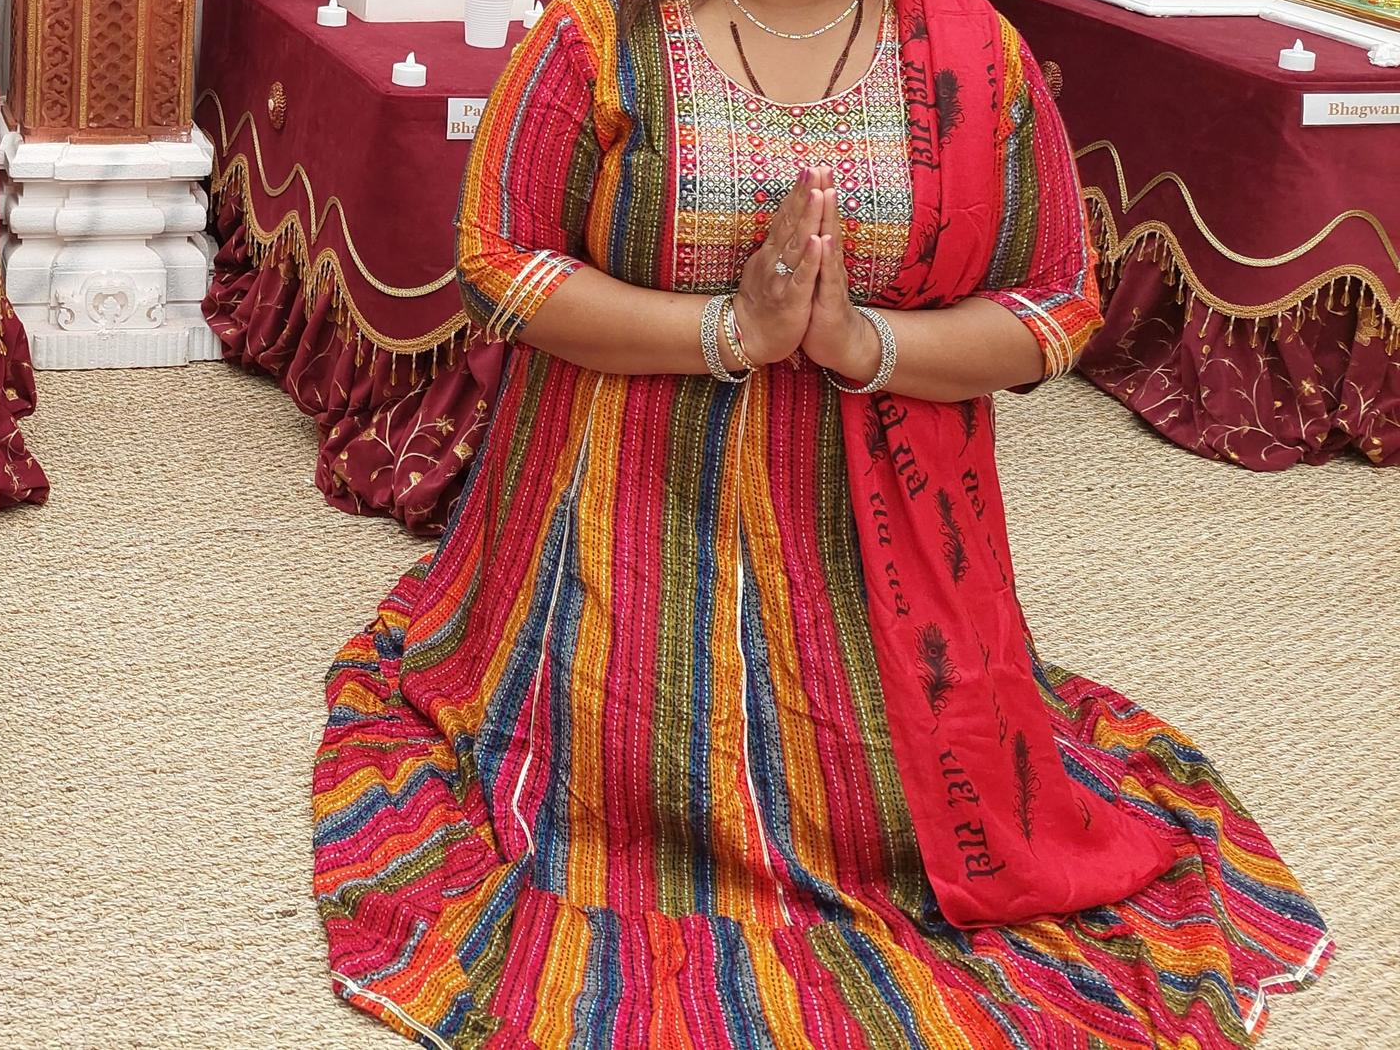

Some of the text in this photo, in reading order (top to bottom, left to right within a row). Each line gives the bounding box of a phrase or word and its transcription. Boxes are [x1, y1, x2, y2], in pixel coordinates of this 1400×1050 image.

[463, 104, 483, 117] Pa
[1328, 101, 1400, 118] Bhagwan
[450, 121, 477, 134] Bha
[892, 438, 929, 503] राधे
[954, 818, 1006, 882] राधे
